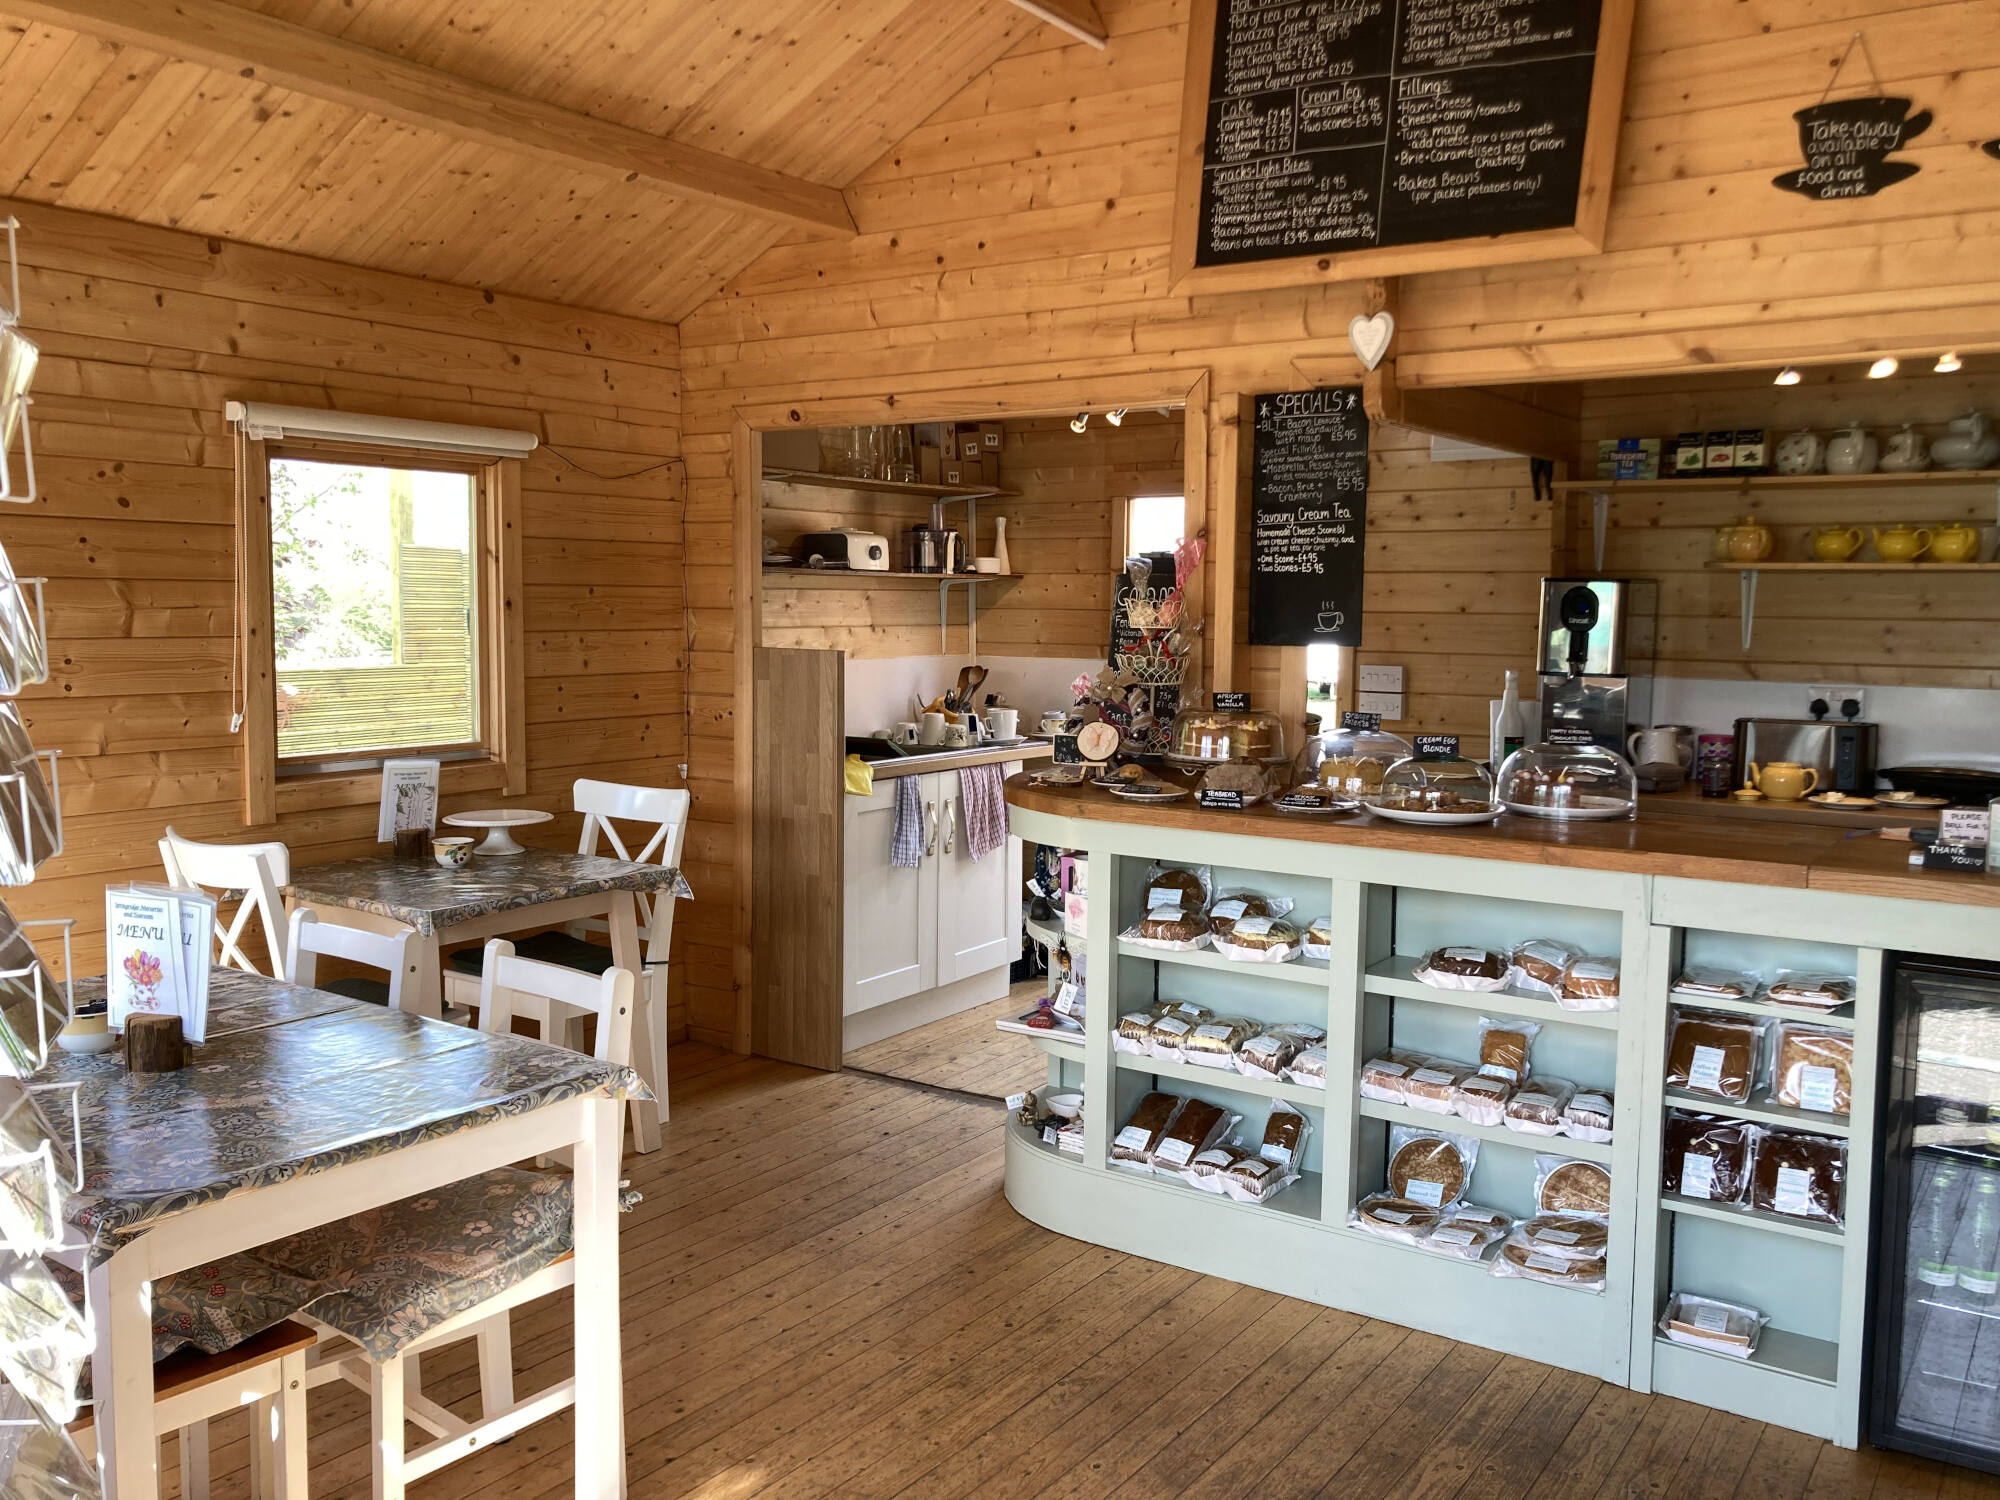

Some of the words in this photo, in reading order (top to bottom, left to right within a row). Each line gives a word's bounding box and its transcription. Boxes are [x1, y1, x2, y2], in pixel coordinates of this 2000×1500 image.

[1230, 14, 1248, 29] Pot
[1249, 12, 1261, 29] of
[1263, 10, 1280, 24] tea
[1305, 3, 1328, 18] one
[1411, 5, 1452, 23] Toasted
[1229, 28, 1275, 45] Lavazza
[1278, 22, 1311, 39] Coffee
[1410, 22, 1453, 38] Paninis
[1552, 28, 1574, 41] and
[1229, 42, 1272, 59] Lavazza
[1277, 33, 1321, 51] Espresso
[1407, 37, 1446, 53] Jacket
[1448, 30, 1491, 46] Potato
[1228, 58, 1245, 71] Hot
[1246, 49, 1292, 67] Chocolate
[1275, 60, 1298, 73] Teas
[1264, 74, 1290, 93] Coffee
[1289, 72, 1306, 87] for
[1306, 68, 1325, 81] one
[1399, 78, 1450, 100] Fillings
[1301, 87, 1340, 106] Cream
[1340, 81, 1362, 101] Tea
[1302, 107, 1321, 120] One
[1320, 103, 1350, 118] scone
[1219, 118, 1245, 136] Large
[1245, 115, 1264, 129] slice
[1302, 119, 1321, 134] Two
[1321, 116, 1353, 131] scones
[1401, 127, 1430, 141] Tuna
[1431, 123, 1467, 140] mayo
[1410, 136, 1434, 150] add
[1434, 132, 1470, 148] cheese
[1525, 122, 1554, 137] melt
[1806, 134, 1880, 155] available
[1504, 141, 1526, 156] Red
[1529, 138, 1566, 153] Onion
[1282, 157, 1312, 175] Bites
[1474, 154, 1526, 172] Chutney
[1810, 154, 1832, 170] on
[1834, 150, 1857, 167] all
[1229, 182, 1255, 196] slices
[1265, 176, 1289, 191] toast
[1290, 175, 1315, 188] with
[1398, 174, 1437, 192] Baked
[1440, 171, 1481, 188] Beans
[1795, 167, 1836, 189] food
[1836, 166, 1865, 182] and
[1310, 192, 1330, 206] add
[1431, 185, 1466, 204] jacket
[1467, 181, 1512, 199] potatoes
[1820, 182, 1868, 199] drink
[1213, 210, 1262, 226] Homemade
[1262, 207, 1289, 222] scone
[1212, 224, 1243, 239] Bacon
[1242, 217, 1288, 236] Sandwich
[1319, 214, 1339, 228] add
[1338, 214, 1354, 230] egg
[1212, 237, 1242, 252] Beans
[1241, 237, 1255, 250] on
[1256, 233, 1281, 248] toast
[1313, 228, 1333, 243] add
[1332, 226, 1360, 240] cheese
[1272, 389, 1344, 417] SPECIALS
[1260, 418, 1287, 433] BLT
[1304, 423, 1345, 437] Sandwich
[1275, 437, 1297, 446] with
[1297, 433, 1322, 449] mayo
[1260, 446, 1290, 460] Special
[1332, 466, 1363, 479] Rocket
[1296, 480, 1317, 492] Brie
[1278, 489, 1324, 505] Cranberry
[1256, 508, 1296, 530] Savoury
[1297, 506, 1331, 522] Cream
[1332, 502, 1353, 520] Tea
[1256, 527, 1293, 539] Homemade
[1291, 525, 1317, 537] Cheese
[1340, 534, 1356, 545] and
[1289, 543, 1302, 553] tea
[1302, 544, 1314, 555] for
[1313, 543, 1327, 553] one
[1260, 553, 1275, 564] One
[1274, 553, 1296, 565] Scone
[1260, 563, 1274, 574] Two
[1273, 562, 1299, 574] Scones
[1417, 736, 1444, 744] CREAM
[1422, 745, 1451, 754] BLONDIE
[1951, 813, 1983, 821] PLEASE
[1927, 845, 1967, 856] THANK
[116, 922, 166, 941] MENU
